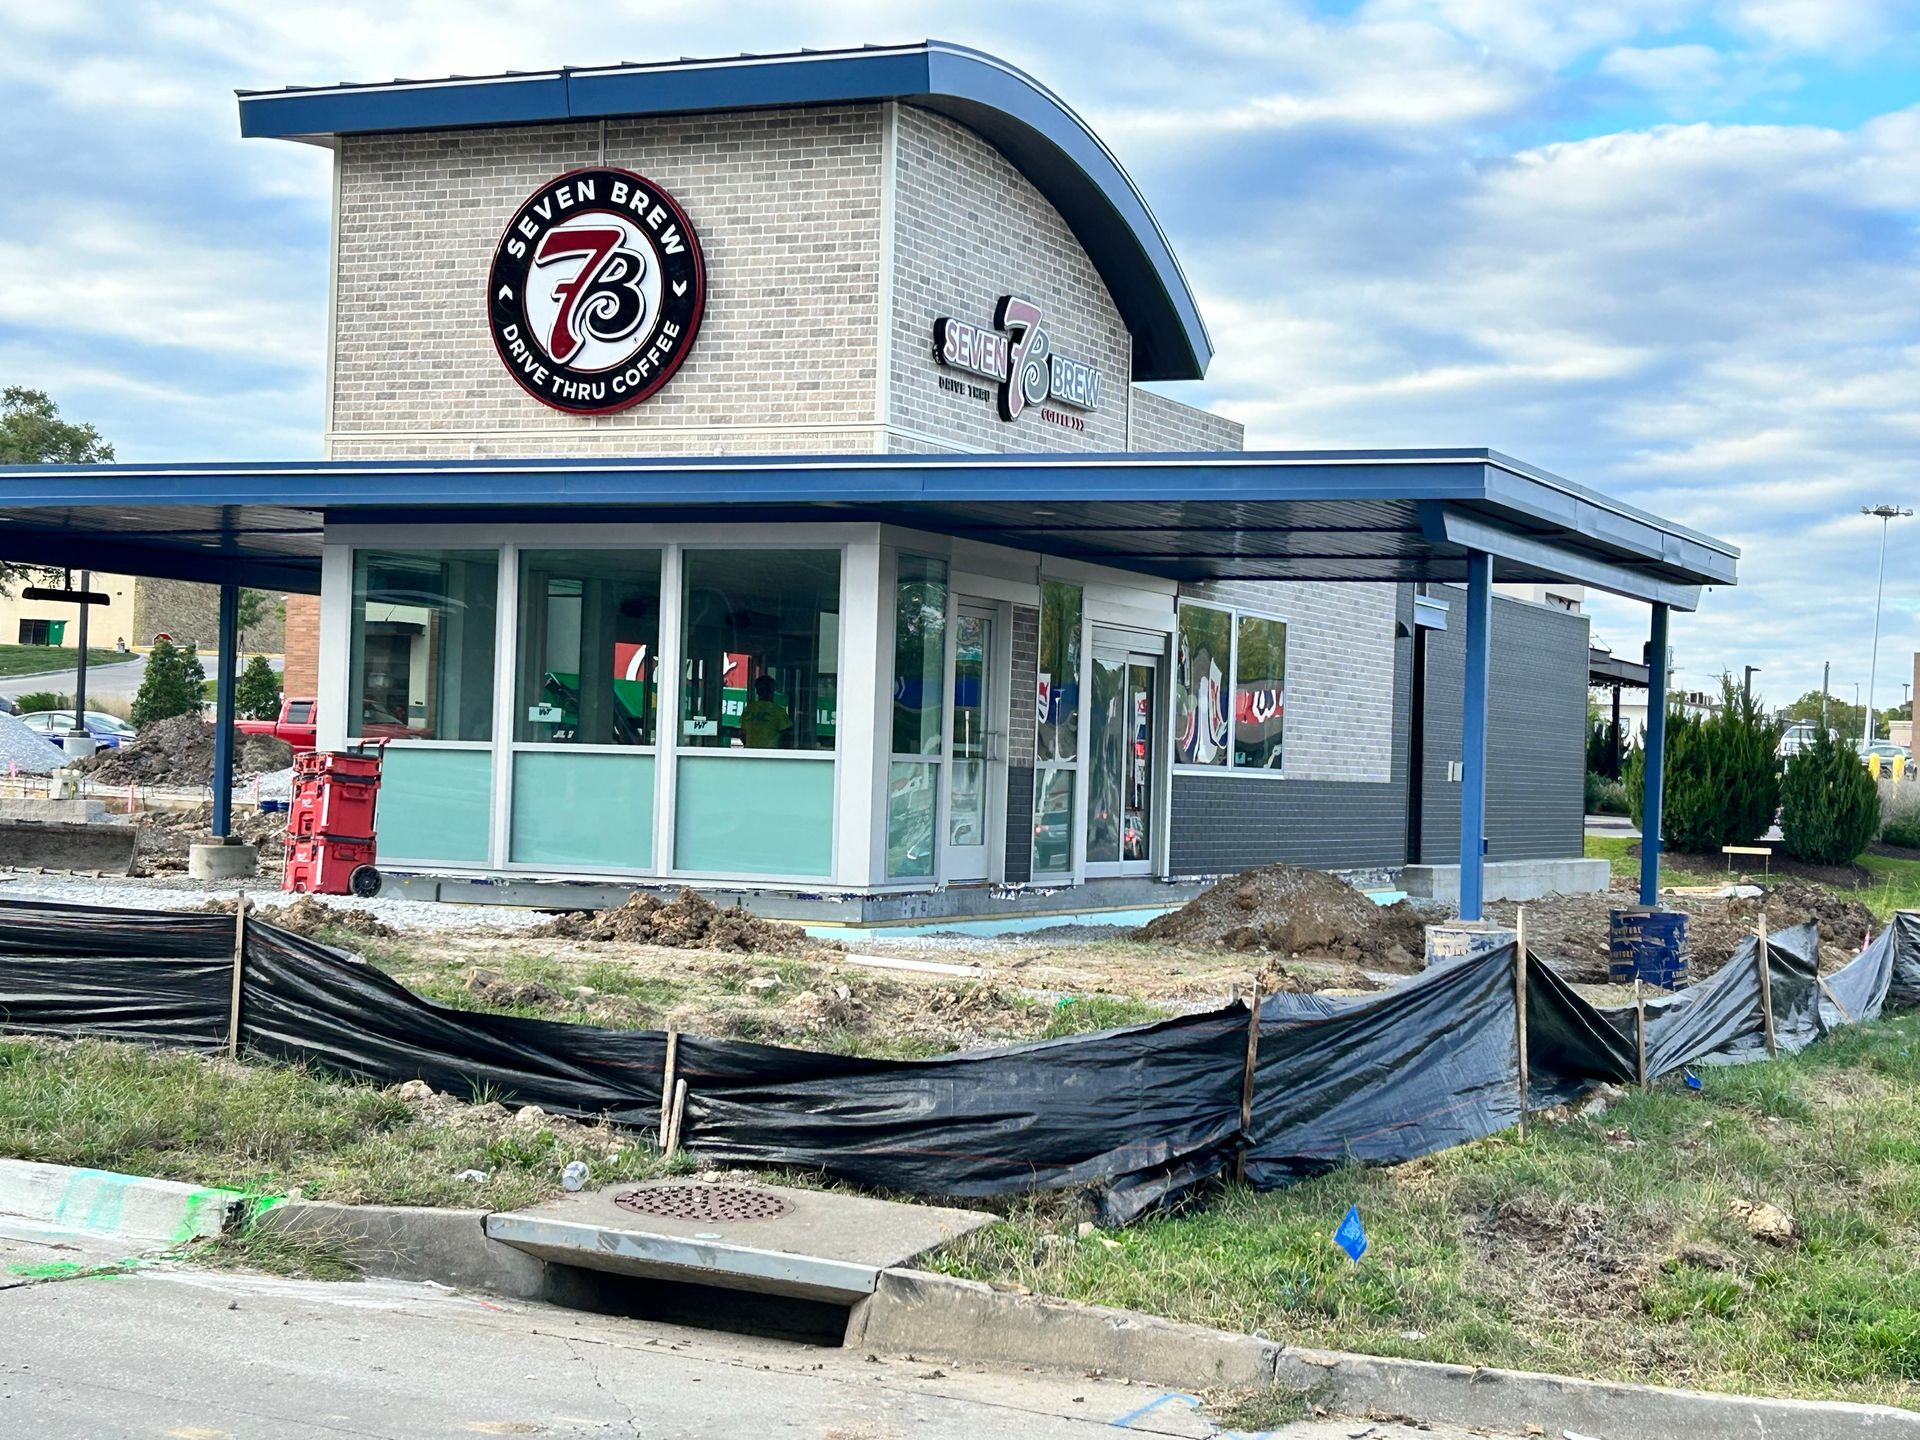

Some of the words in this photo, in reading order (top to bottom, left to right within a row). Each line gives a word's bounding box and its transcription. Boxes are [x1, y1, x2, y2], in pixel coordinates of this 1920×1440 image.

[507, 179, 596, 259] SEVEN
[610, 181, 685, 256] BREW
[503, 324, 549, 386] DRIVE
[551, 376, 605, 400] THRU
[612, 320, 680, 393] COFFEE
[943, 318, 1008, 380] SEVEN
[938, 375, 966, 395] DRIVE
[1051, 354, 1102, 409] BREW
